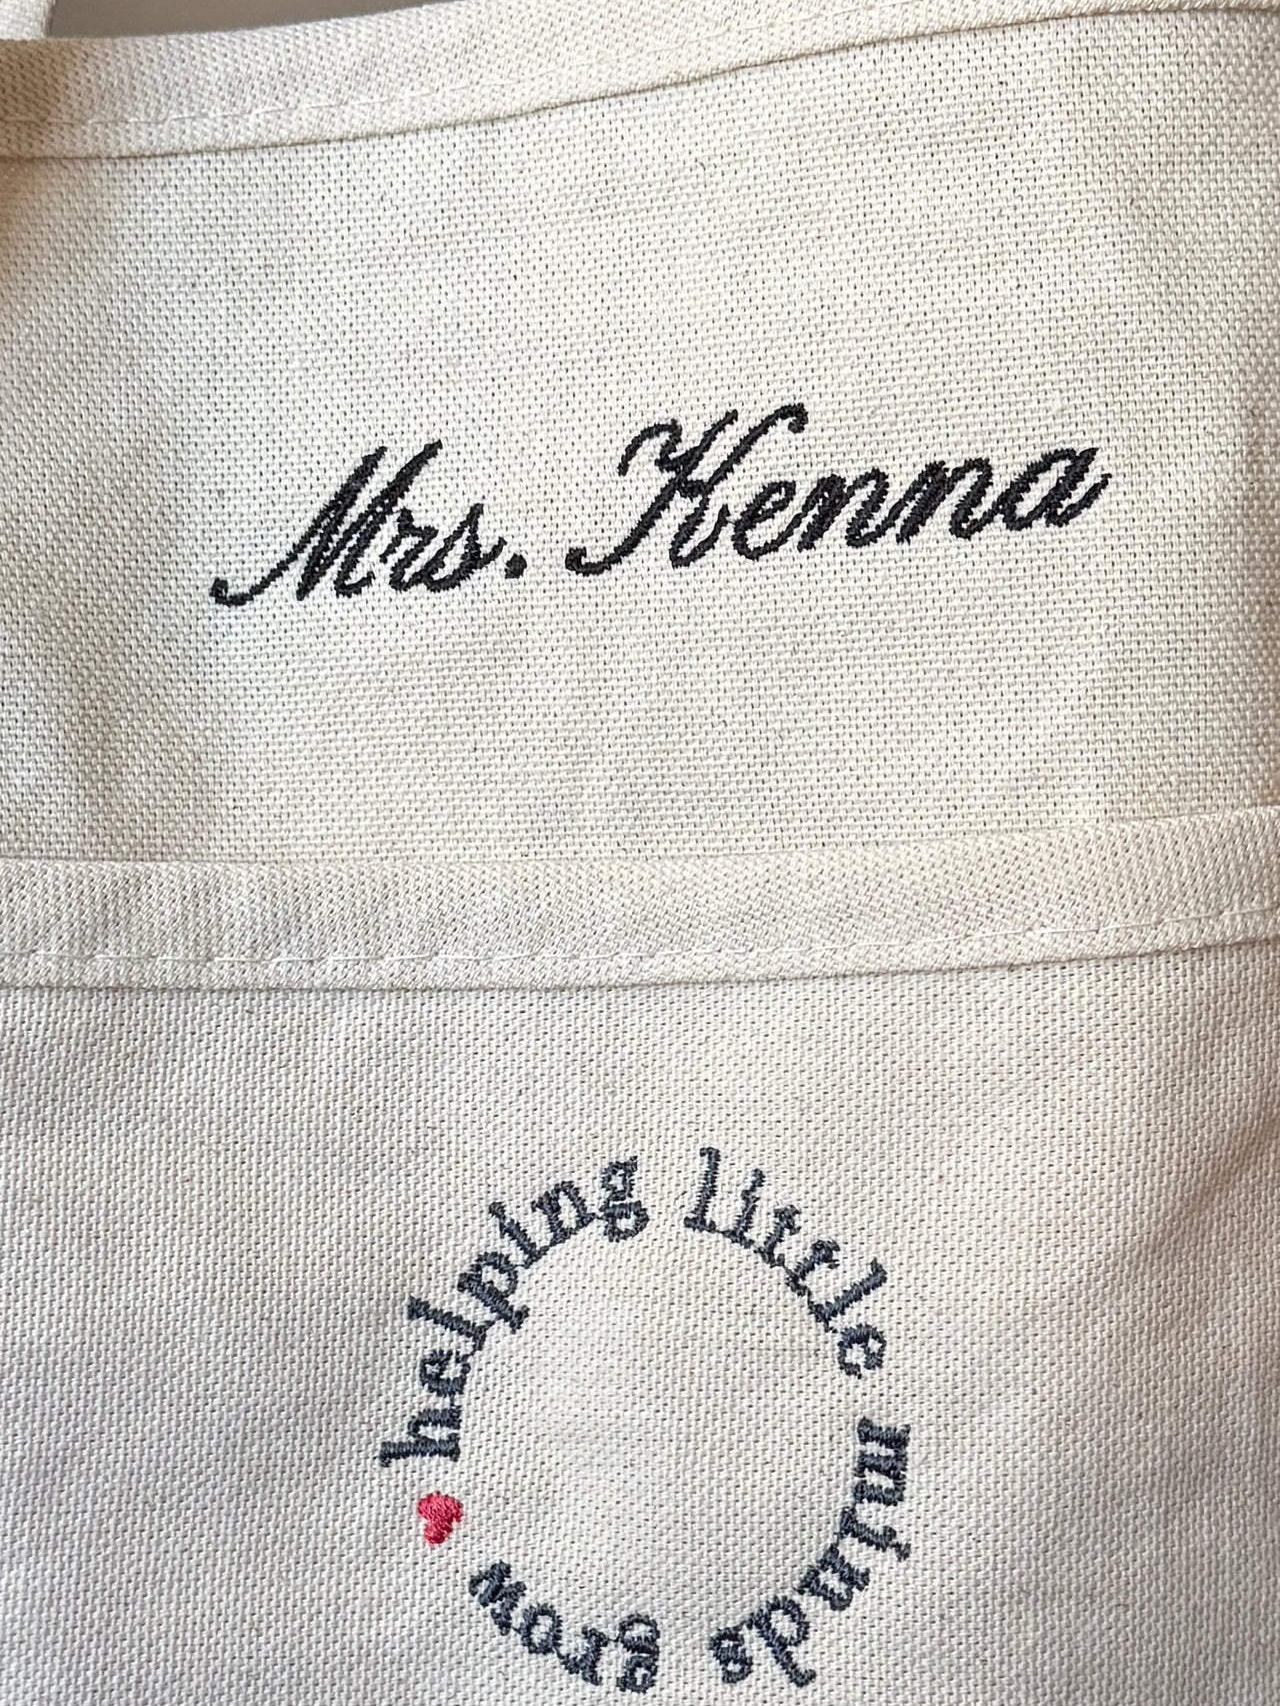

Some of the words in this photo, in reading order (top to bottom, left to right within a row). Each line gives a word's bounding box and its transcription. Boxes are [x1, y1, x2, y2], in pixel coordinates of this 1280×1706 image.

[208, 439, 527, 607] Mrs.
[565, 403, 1113, 575] Kenna
[376, 1156, 650, 1467] helping
[684, 1147, 888, 1378] little
[469, 1560, 661, 1693] grow
[708, 1416, 911, 1688] minds
